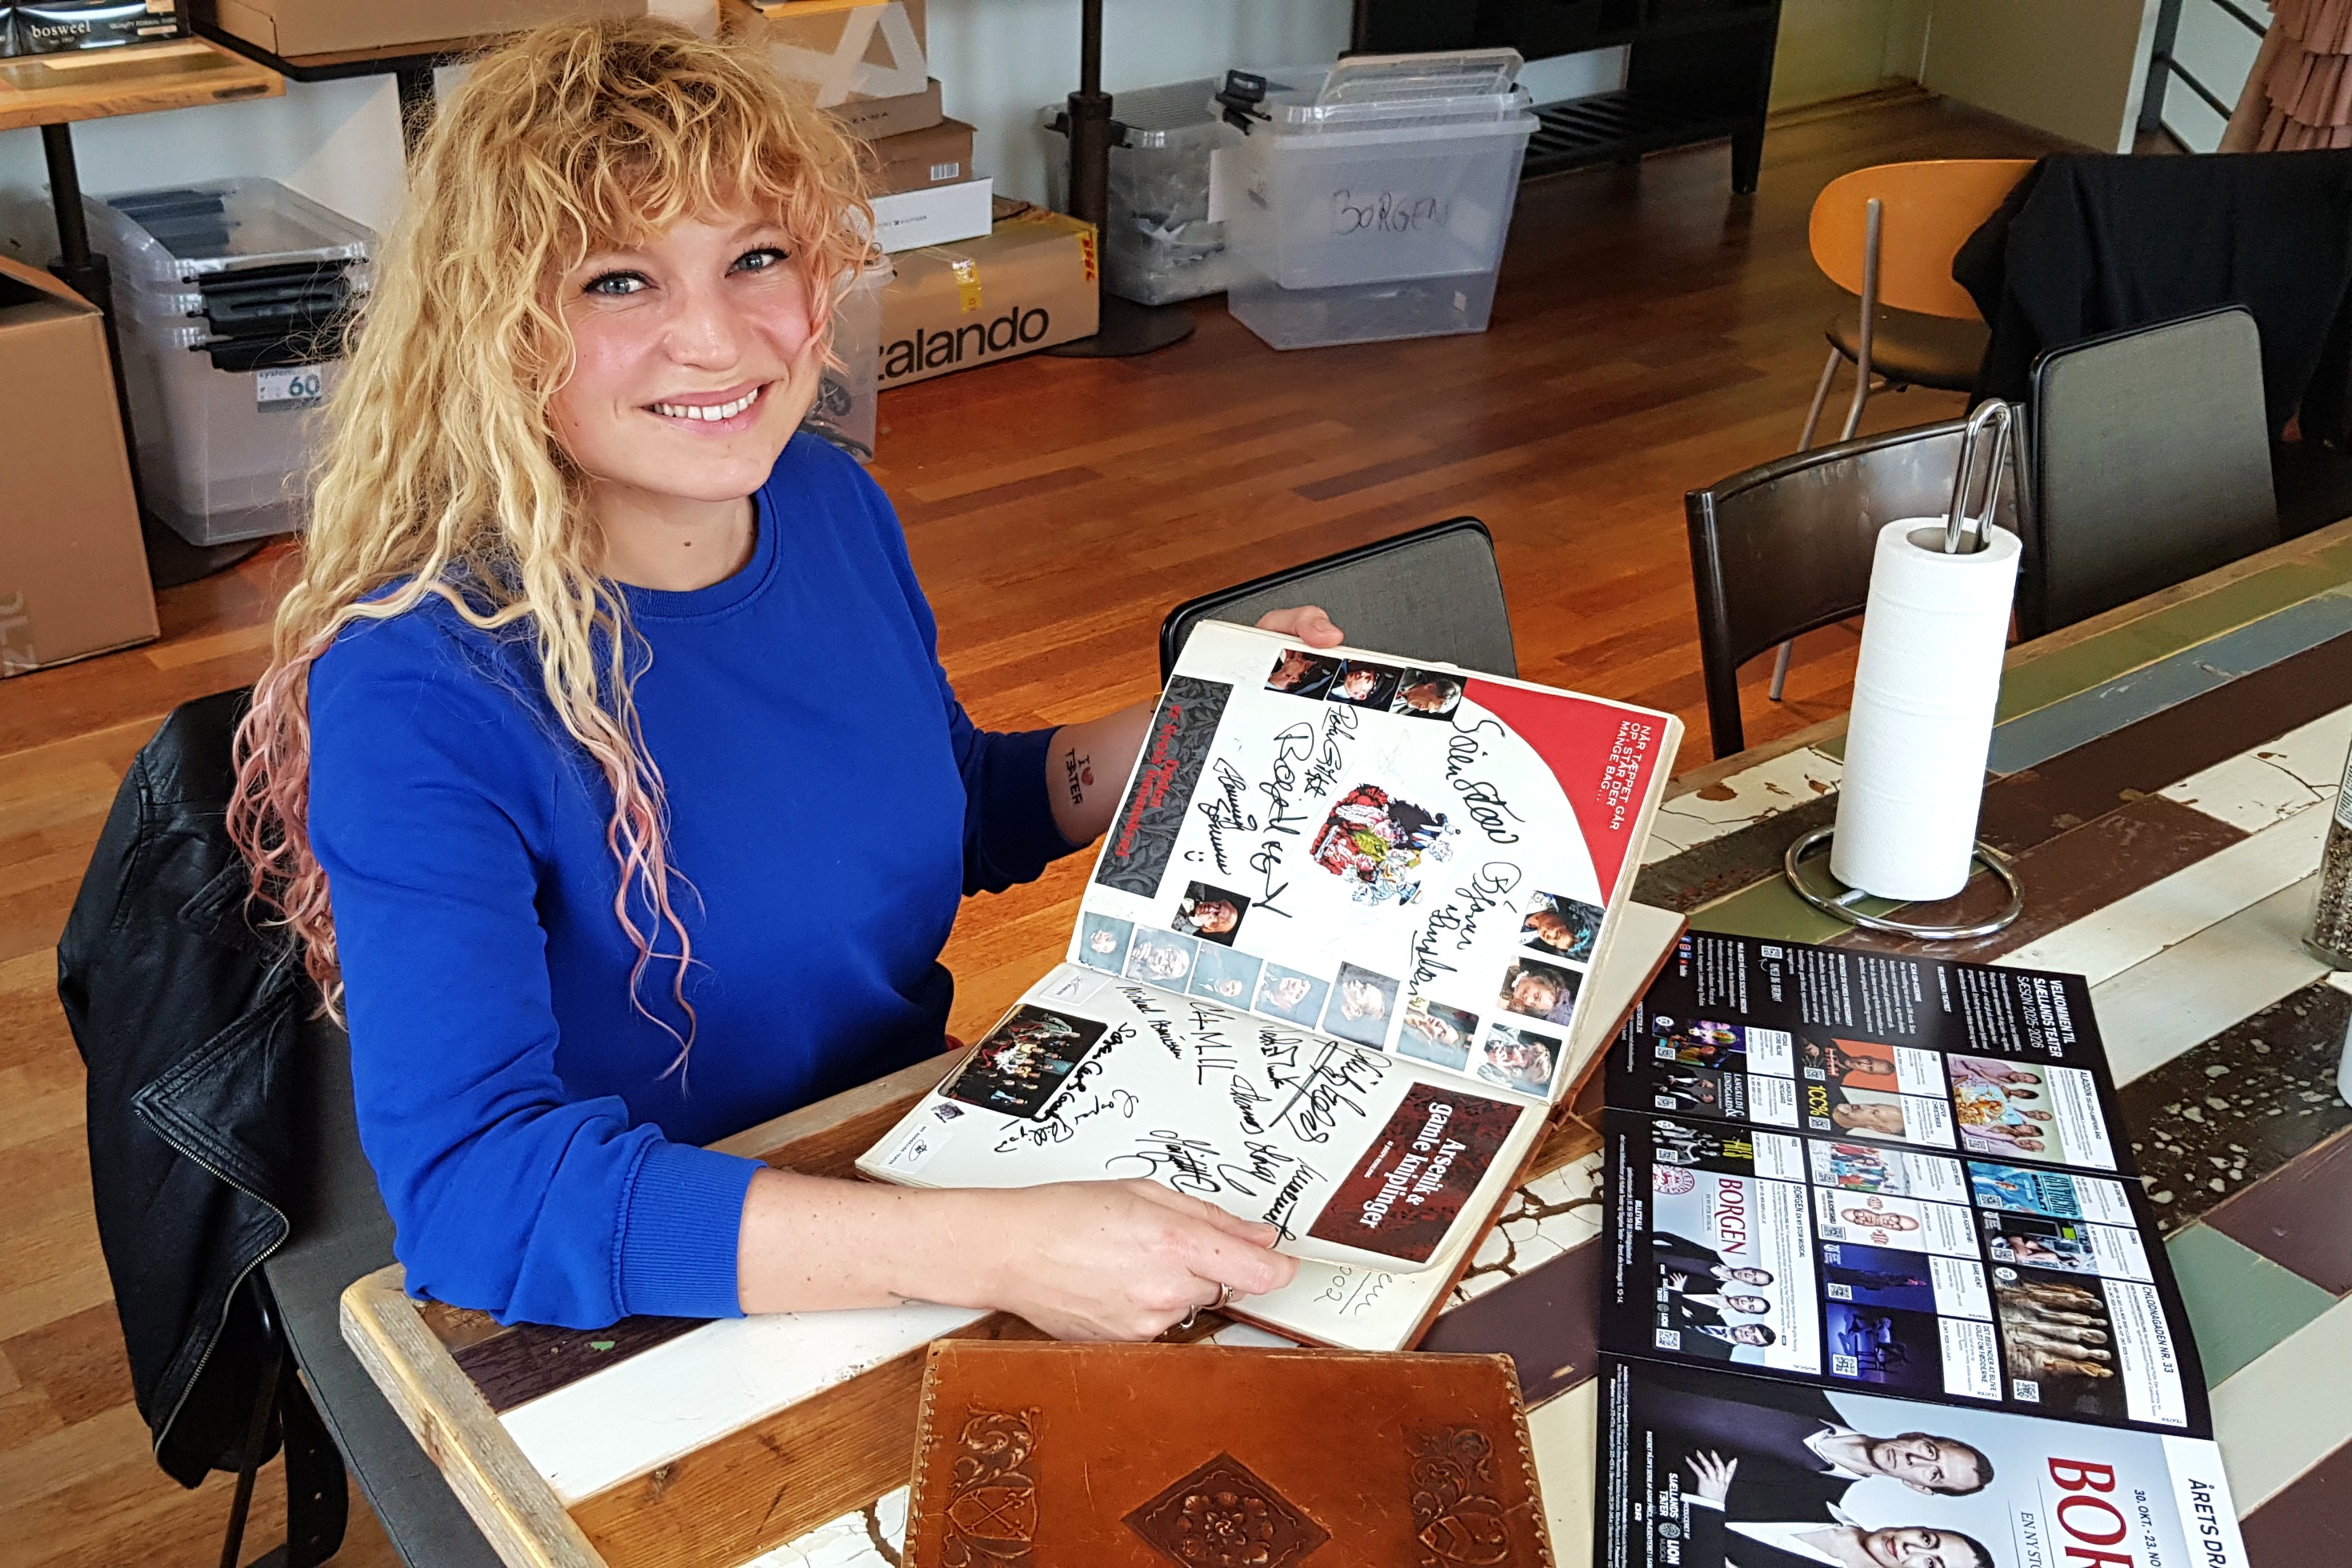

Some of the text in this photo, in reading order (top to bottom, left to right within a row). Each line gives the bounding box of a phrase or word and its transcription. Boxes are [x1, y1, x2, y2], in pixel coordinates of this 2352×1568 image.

[30, 20, 91, 38] bosweel
[289, 373, 320, 396] 60
[1610, 720, 1630, 762] MANGE
[1610, 725, 1650, 830] NÅR TÆPPET GÅR
[1616, 746, 1632, 778] STÅR
[1606, 781, 1622, 806] DER
[2017, 976, 2044, 1049] SÆSON 2025-2026
[2034, 978, 2055, 1026] SJÆLLANDS
[2050, 980, 2076, 1044] VELKOMMEN TIL
[2044, 1026, 2063, 1058] TEATER
[1723, 1072, 1733, 1110] LUNDGAARD
[1734, 1074, 1744, 1110] LANGKILDE
[1412, 1102, 1453, 1151] gamle
[1406, 1138, 1466, 1206] Arsenik &
[1360, 1153, 1429, 1228] kniplinger
[1793, 1186, 1804, 1214] BORGEN
[1714, 1178, 1747, 1255] BORGEN
[2142, 1286, 2174, 1374] CHLODNAGADEN NR. 33
[1634, 1502, 1642, 1521] DR
[1668, 1473, 1679, 1518] SJÆLLANDS
[2134, 1489, 2146, 1502] 30.
[2188, 1478, 2219, 1536] ÅRETS
[2021, 1511, 2034, 1530] EN
[2138, 1506, 2149, 1528] OKT.
[1667, 1539, 1680, 1566] LION
[2024, 1530, 2039, 1550] NY
[2144, 1535, 2154, 1550] 23.
